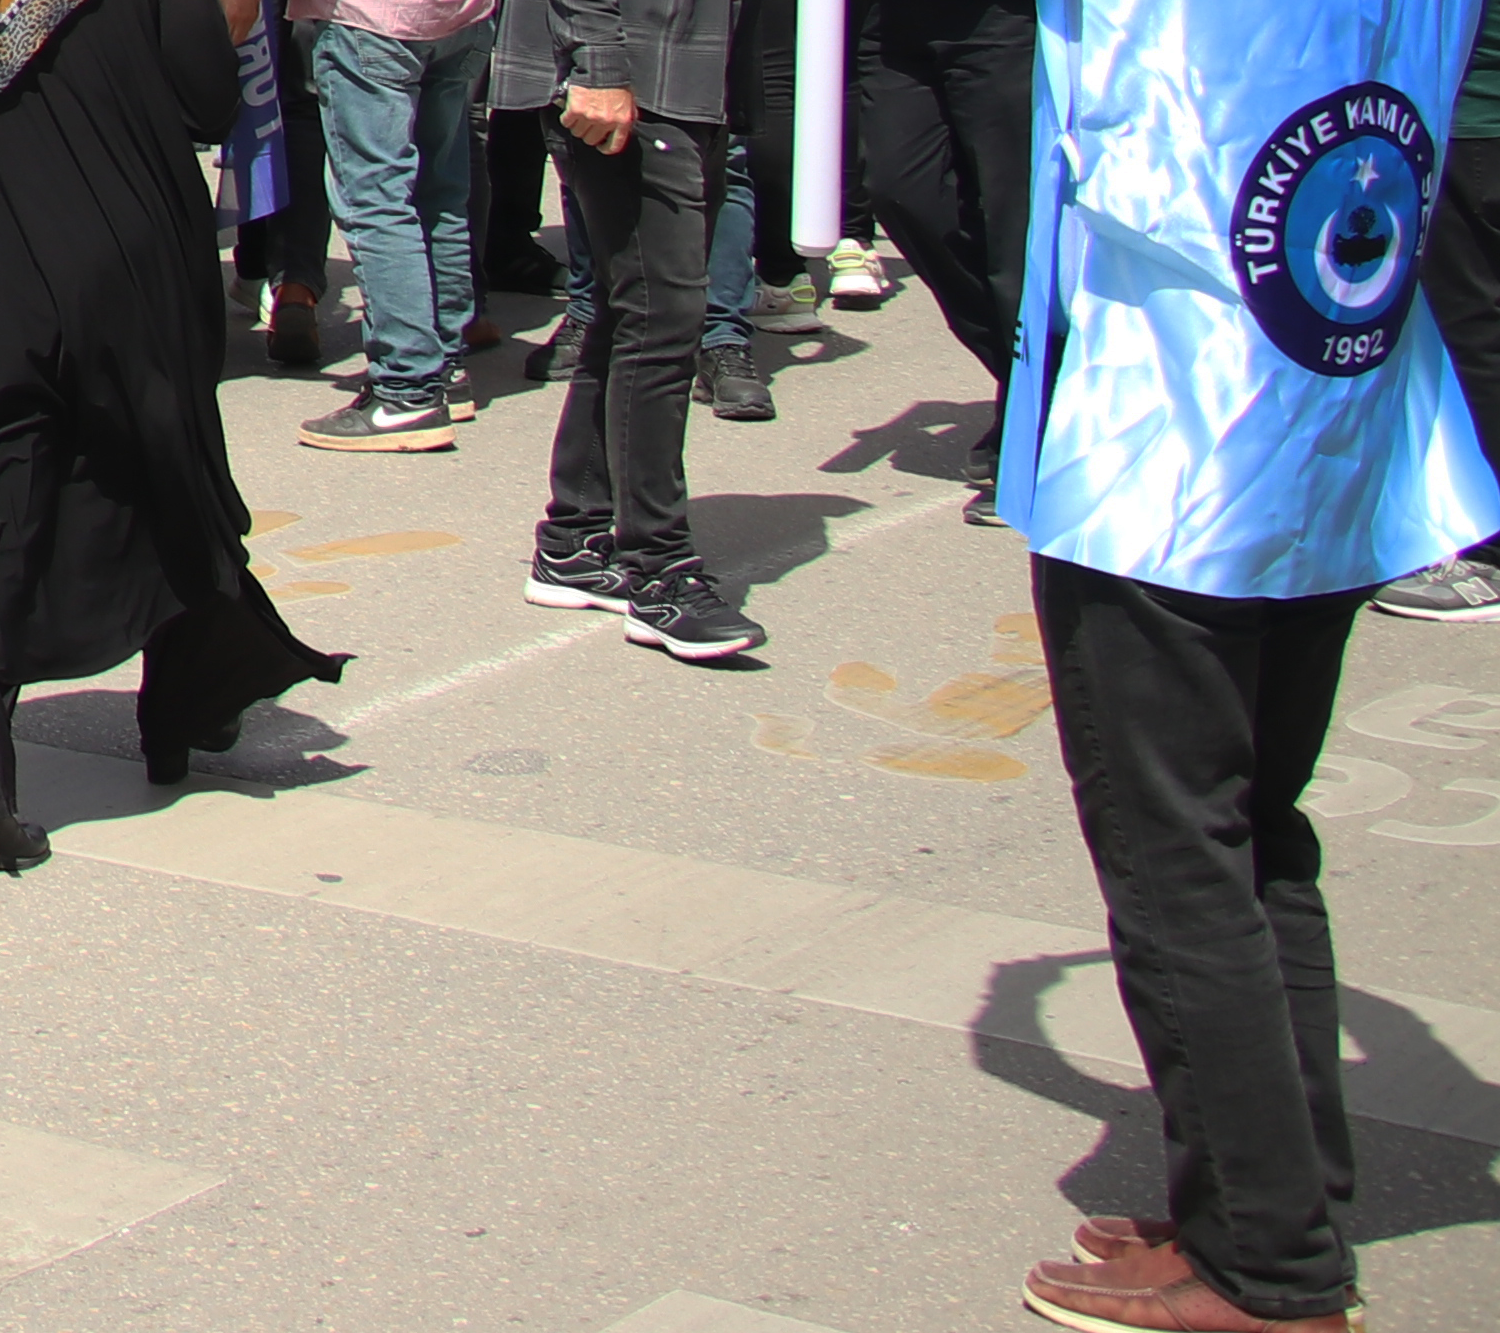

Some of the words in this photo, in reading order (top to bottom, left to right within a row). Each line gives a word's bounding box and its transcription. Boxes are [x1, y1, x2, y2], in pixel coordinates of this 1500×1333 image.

[1234, 110, 1338, 285] TÜRKİYE
[1344, 95, 1418, 147] KAMU
[1321, 328, 1385, 366] 1992
